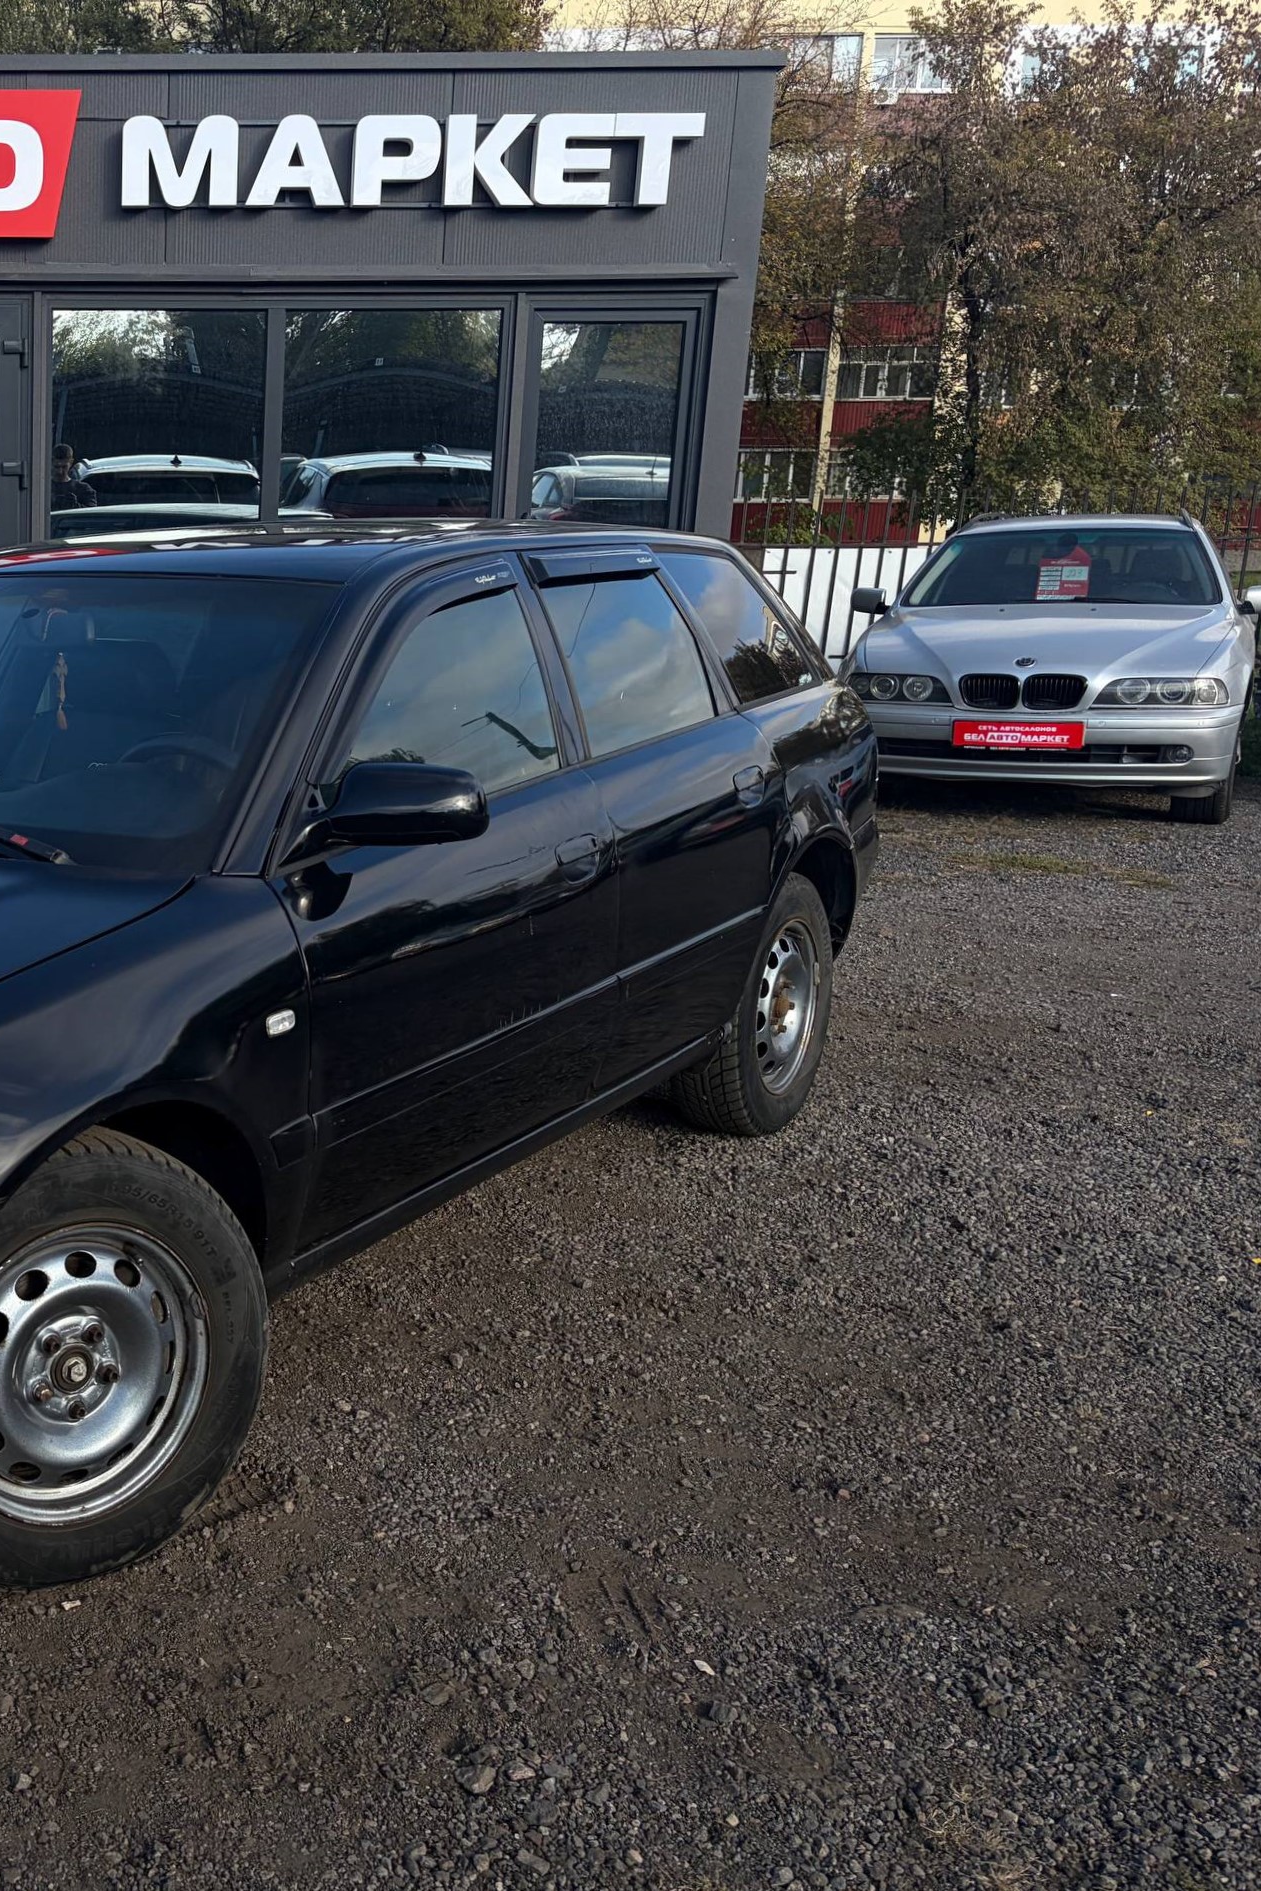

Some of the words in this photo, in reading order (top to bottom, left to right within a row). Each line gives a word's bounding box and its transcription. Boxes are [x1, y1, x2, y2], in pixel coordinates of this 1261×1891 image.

[120, 112, 706, 208] МАРКЕТ
[964, 733, 985, 741] БЕЛ
[988, 734, 1019, 742] АВТО
[1021, 735, 1069, 743] МАРКЕТ
